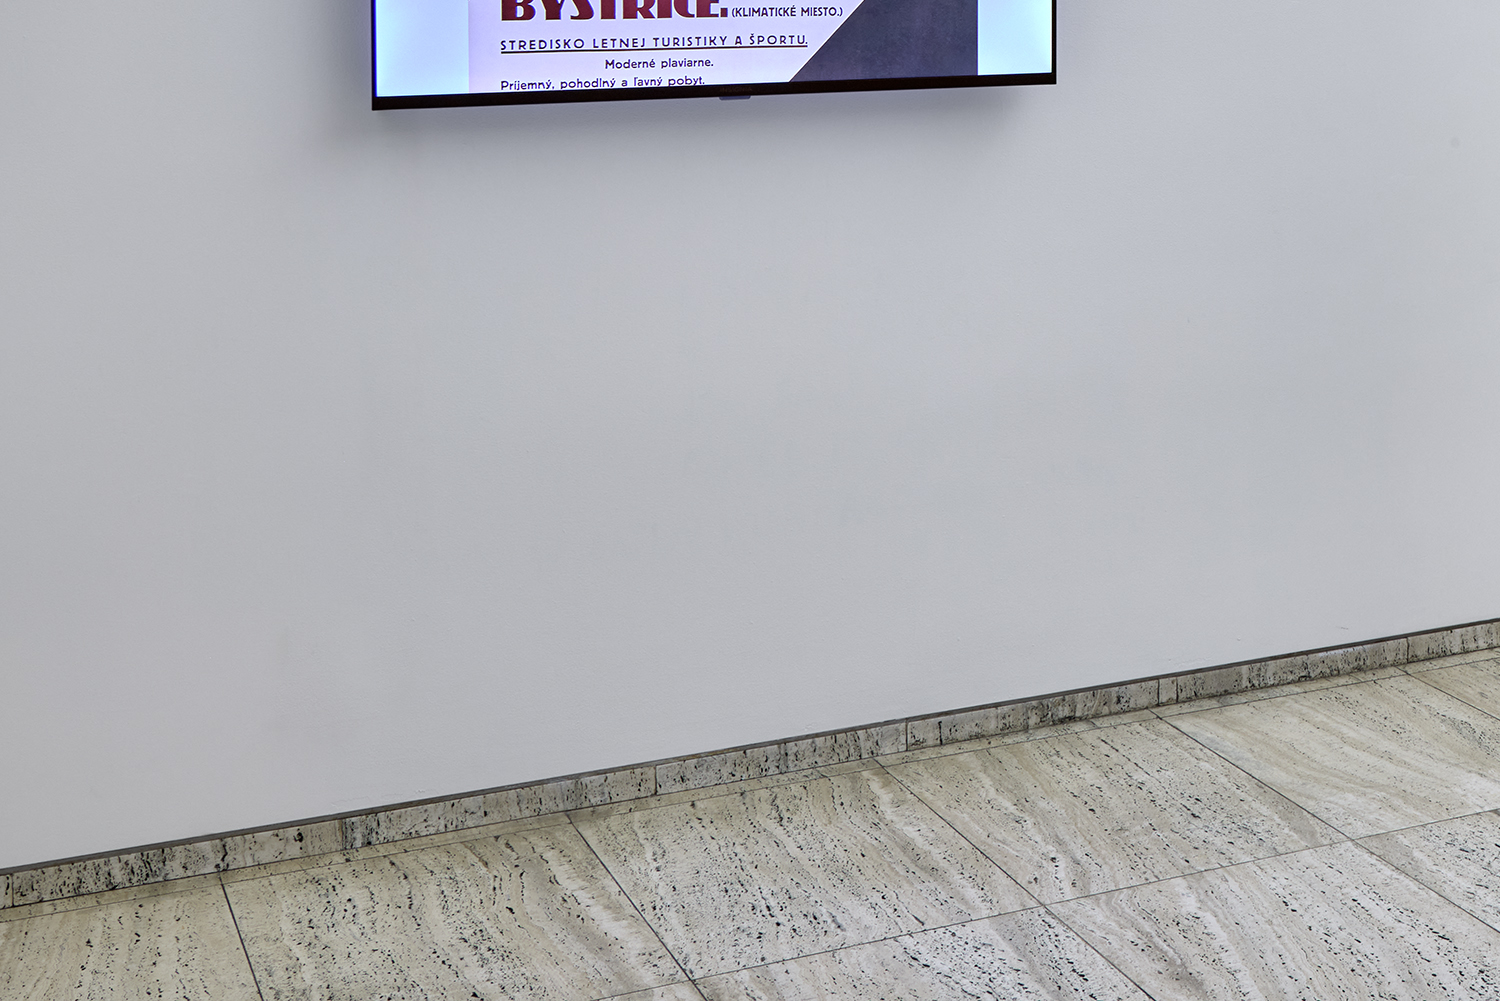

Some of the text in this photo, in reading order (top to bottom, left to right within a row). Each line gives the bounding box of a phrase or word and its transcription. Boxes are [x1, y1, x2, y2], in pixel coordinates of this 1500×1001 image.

[731, 5, 796, 18] (KLIMATICKÉ
[800, 6, 843, 18] MIESTO.)
[500, 33, 808, 50] STREDISKO LETNEJ TURISTIKY A ŠPORTU.
[605, 57, 714, 70] Moderné plaviarne.
[560, 77, 616, 90] pohodlný
[621, 79, 628, 87] a
[668, 75, 704, 87] pobyt.
